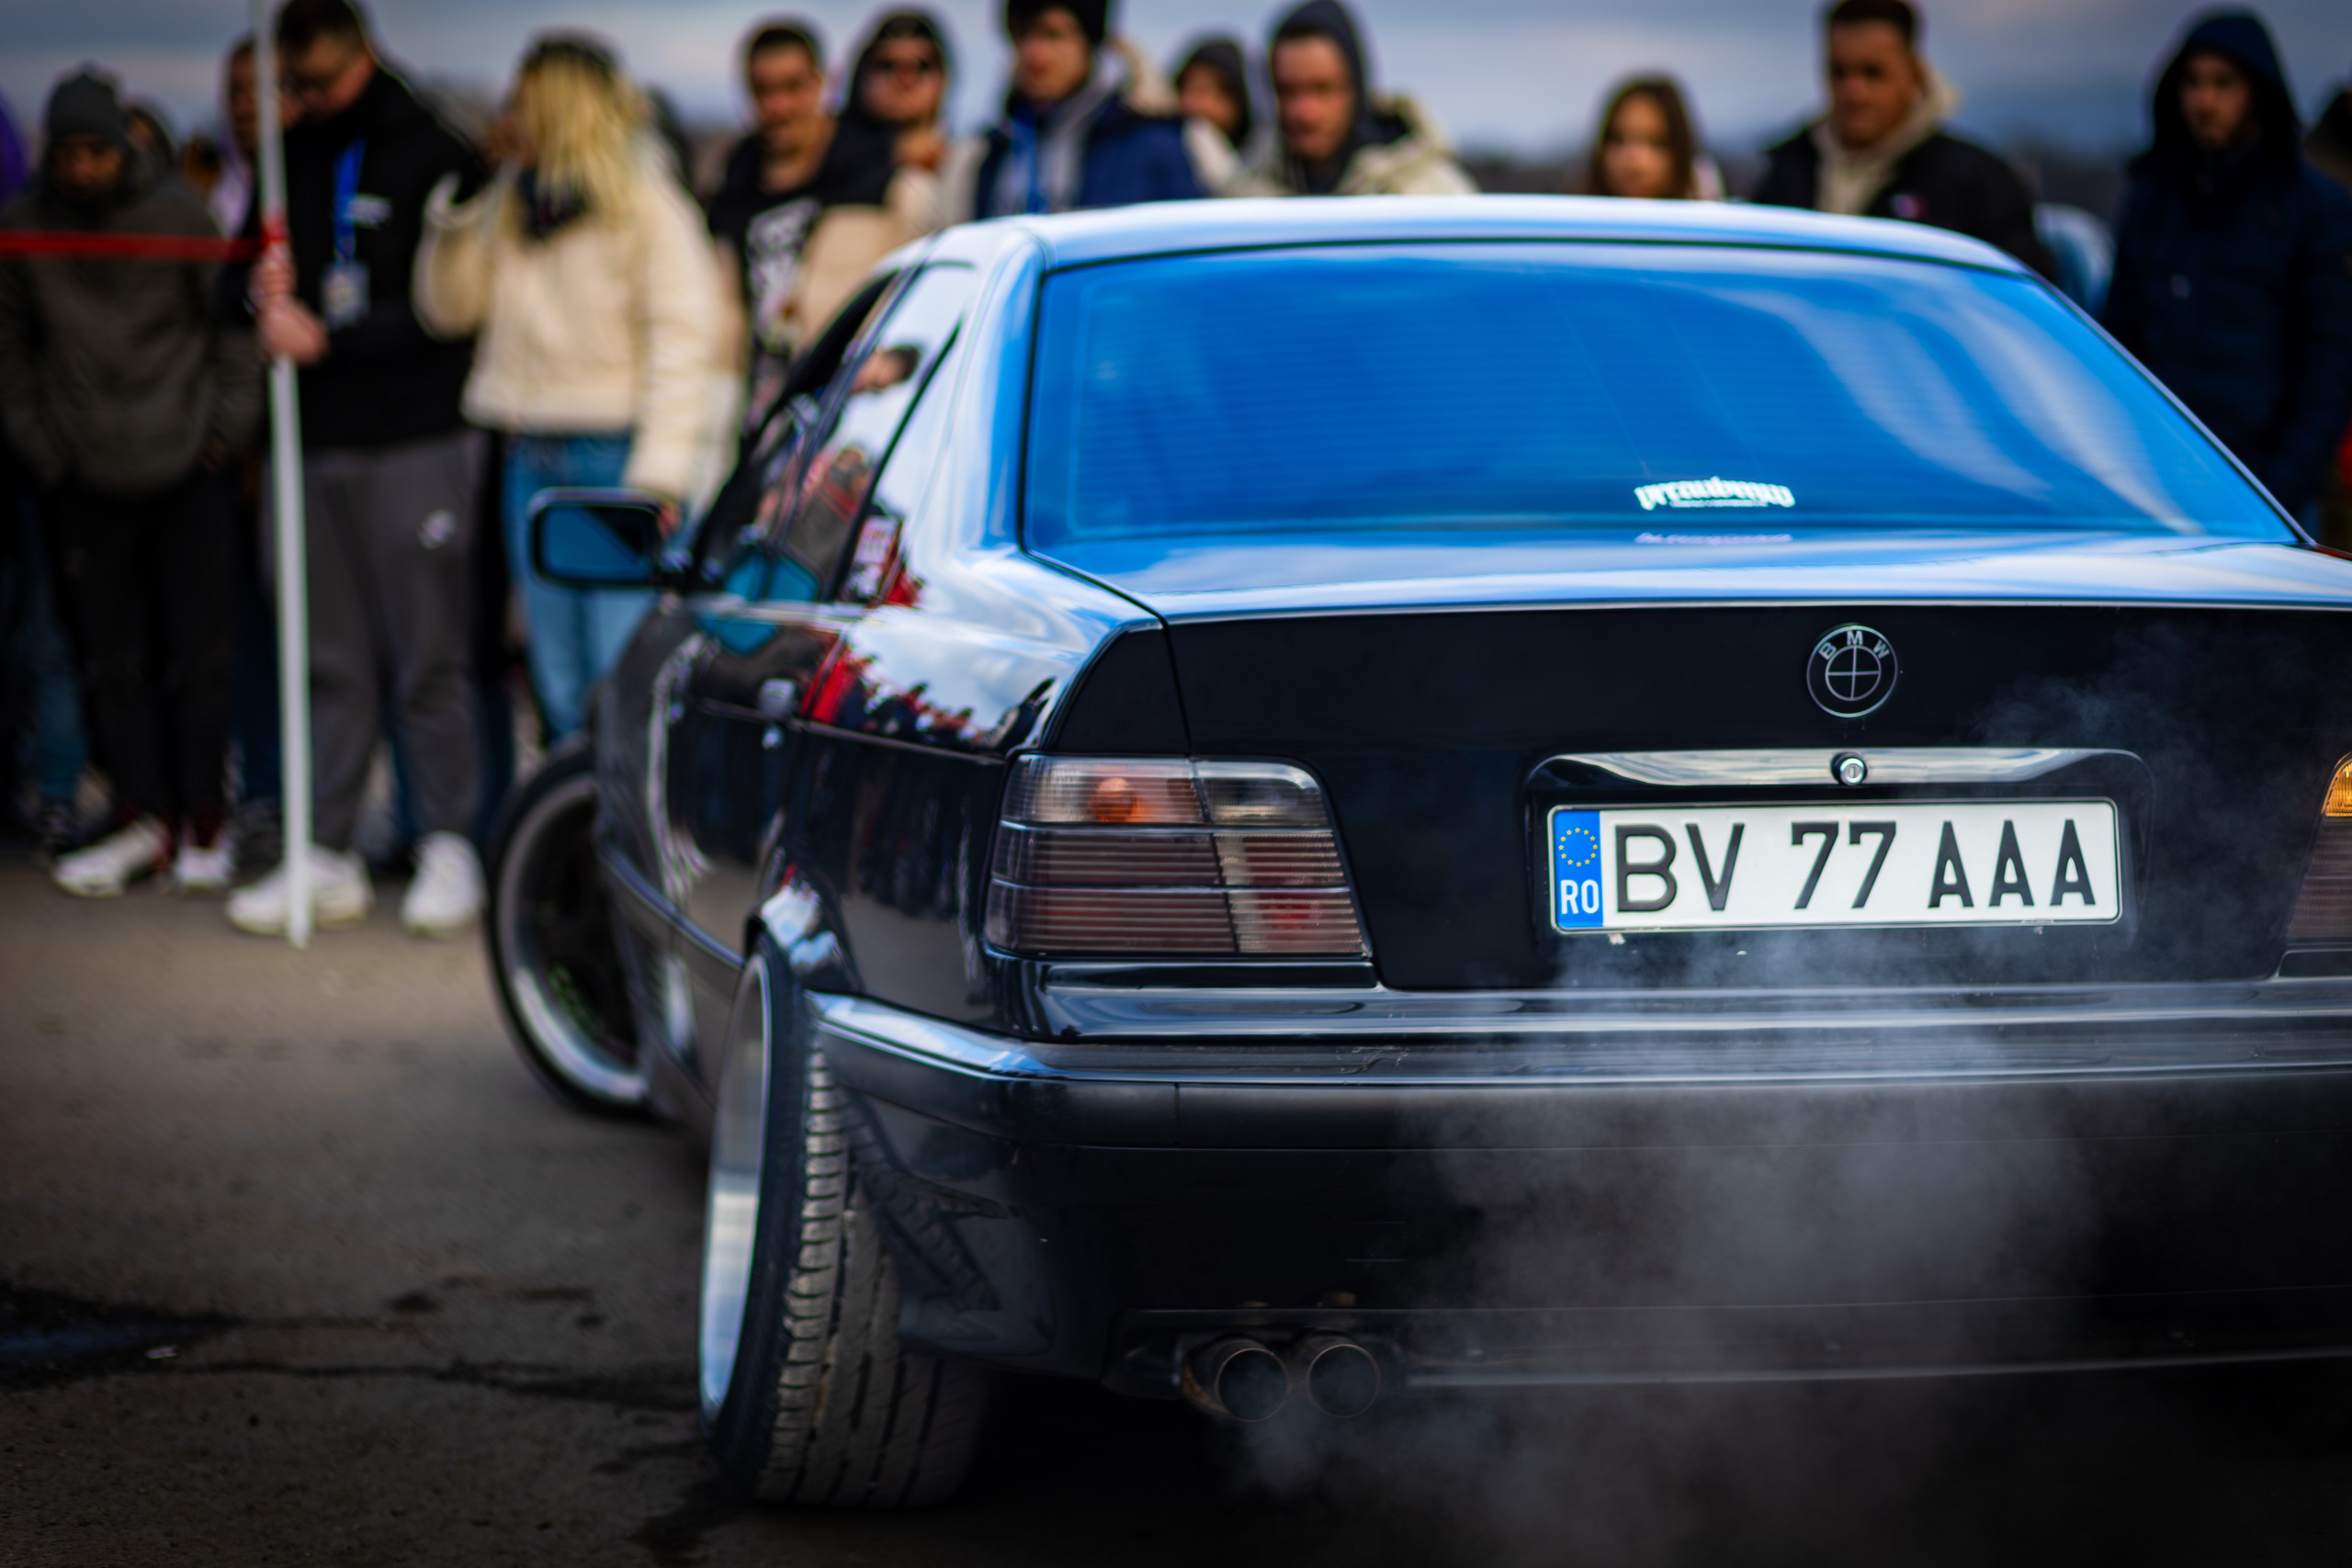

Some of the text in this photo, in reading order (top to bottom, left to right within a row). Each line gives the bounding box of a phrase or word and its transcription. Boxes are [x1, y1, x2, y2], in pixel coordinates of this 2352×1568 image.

[1818, 630, 1890, 660] BMW
[1615, 818, 2096, 913] BV 77 AAA
[1561, 879, 1600, 915] RO
